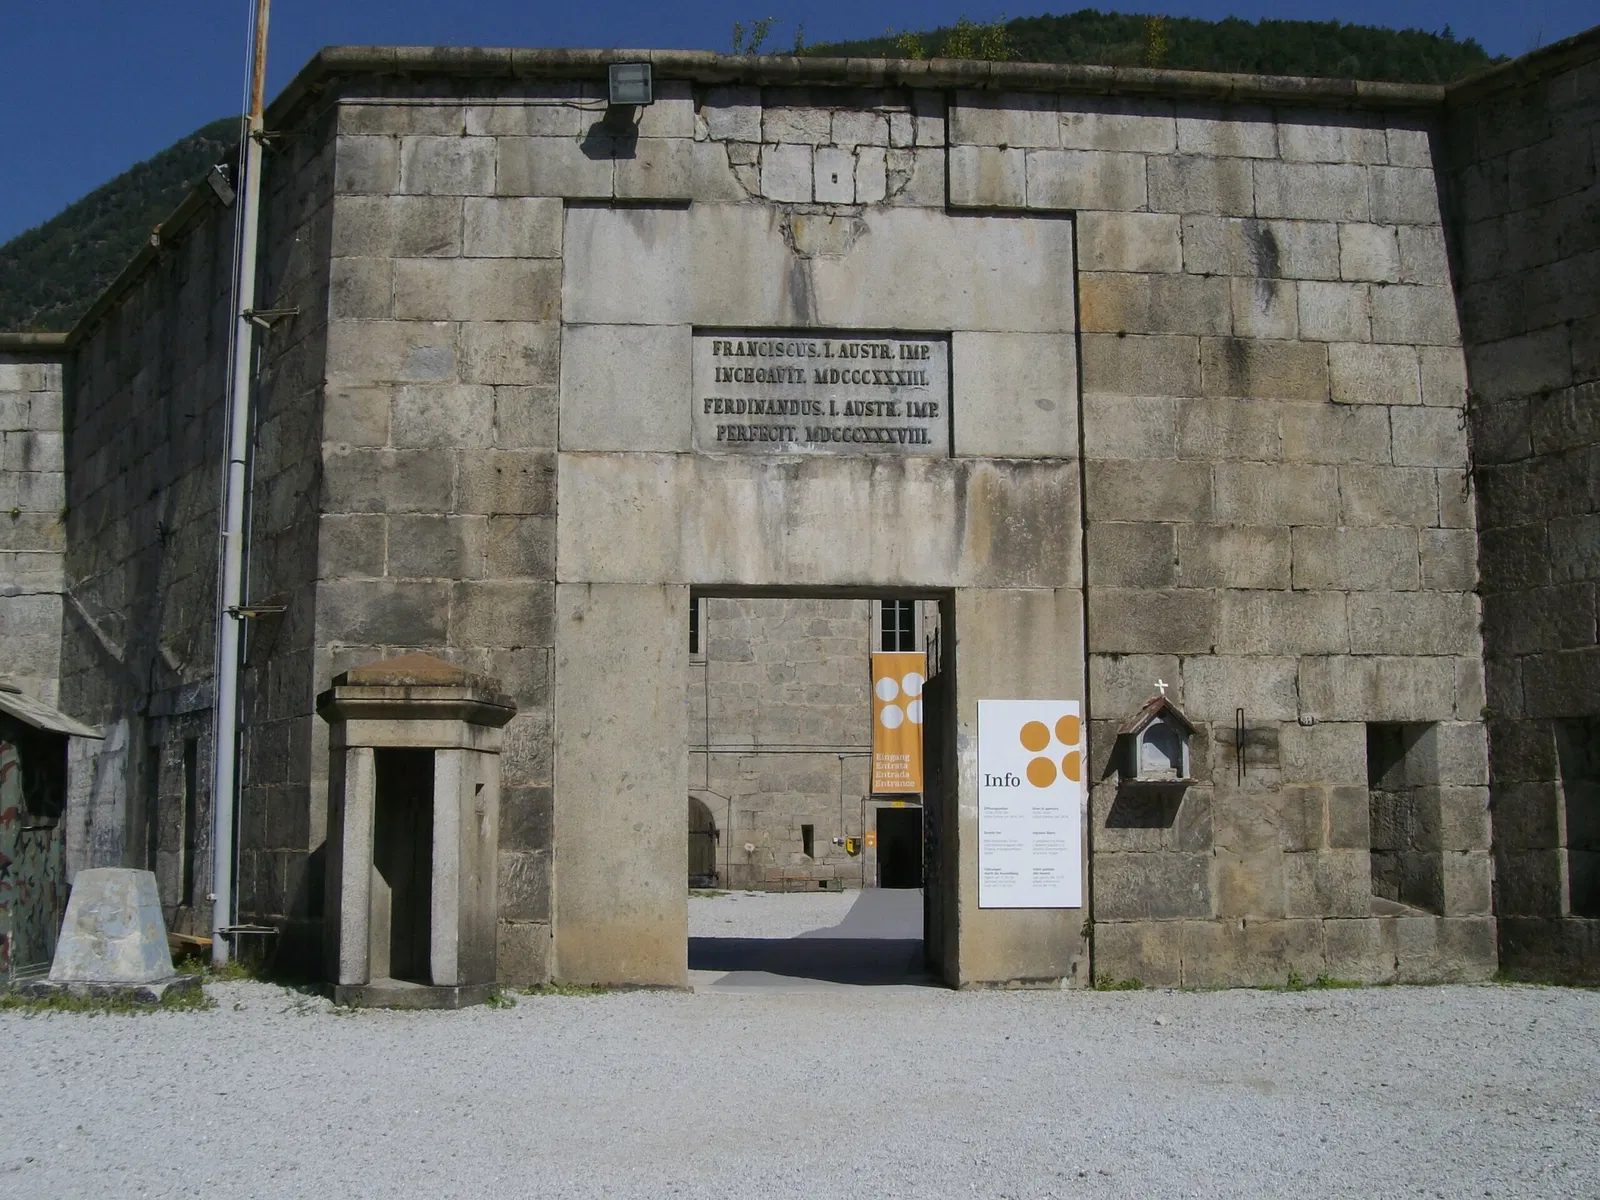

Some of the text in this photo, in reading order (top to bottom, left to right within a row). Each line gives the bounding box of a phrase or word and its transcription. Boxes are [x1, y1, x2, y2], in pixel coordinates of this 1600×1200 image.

[712, 340, 821, 358] FRANCISCUS.
[838, 342, 895, 359] AUSTR.
[899, 344, 931, 360] IMP.
[814, 368, 930, 386] MDCCCXXXIII.
[703, 397, 825, 416] FERDINANDUS.
[843, 400, 901, 417] AUSTR.
[906, 401, 939, 418] IMP.
[716, 424, 932, 444] PERFECIT. MDCCCXXXVIII.
[876, 753, 910, 762] Eingang
[876, 761, 908, 769] Entrata
[876, 770, 910, 778] Entrada
[984, 772, 1021, 787] Info
[875, 779, 915, 787] Entrance
